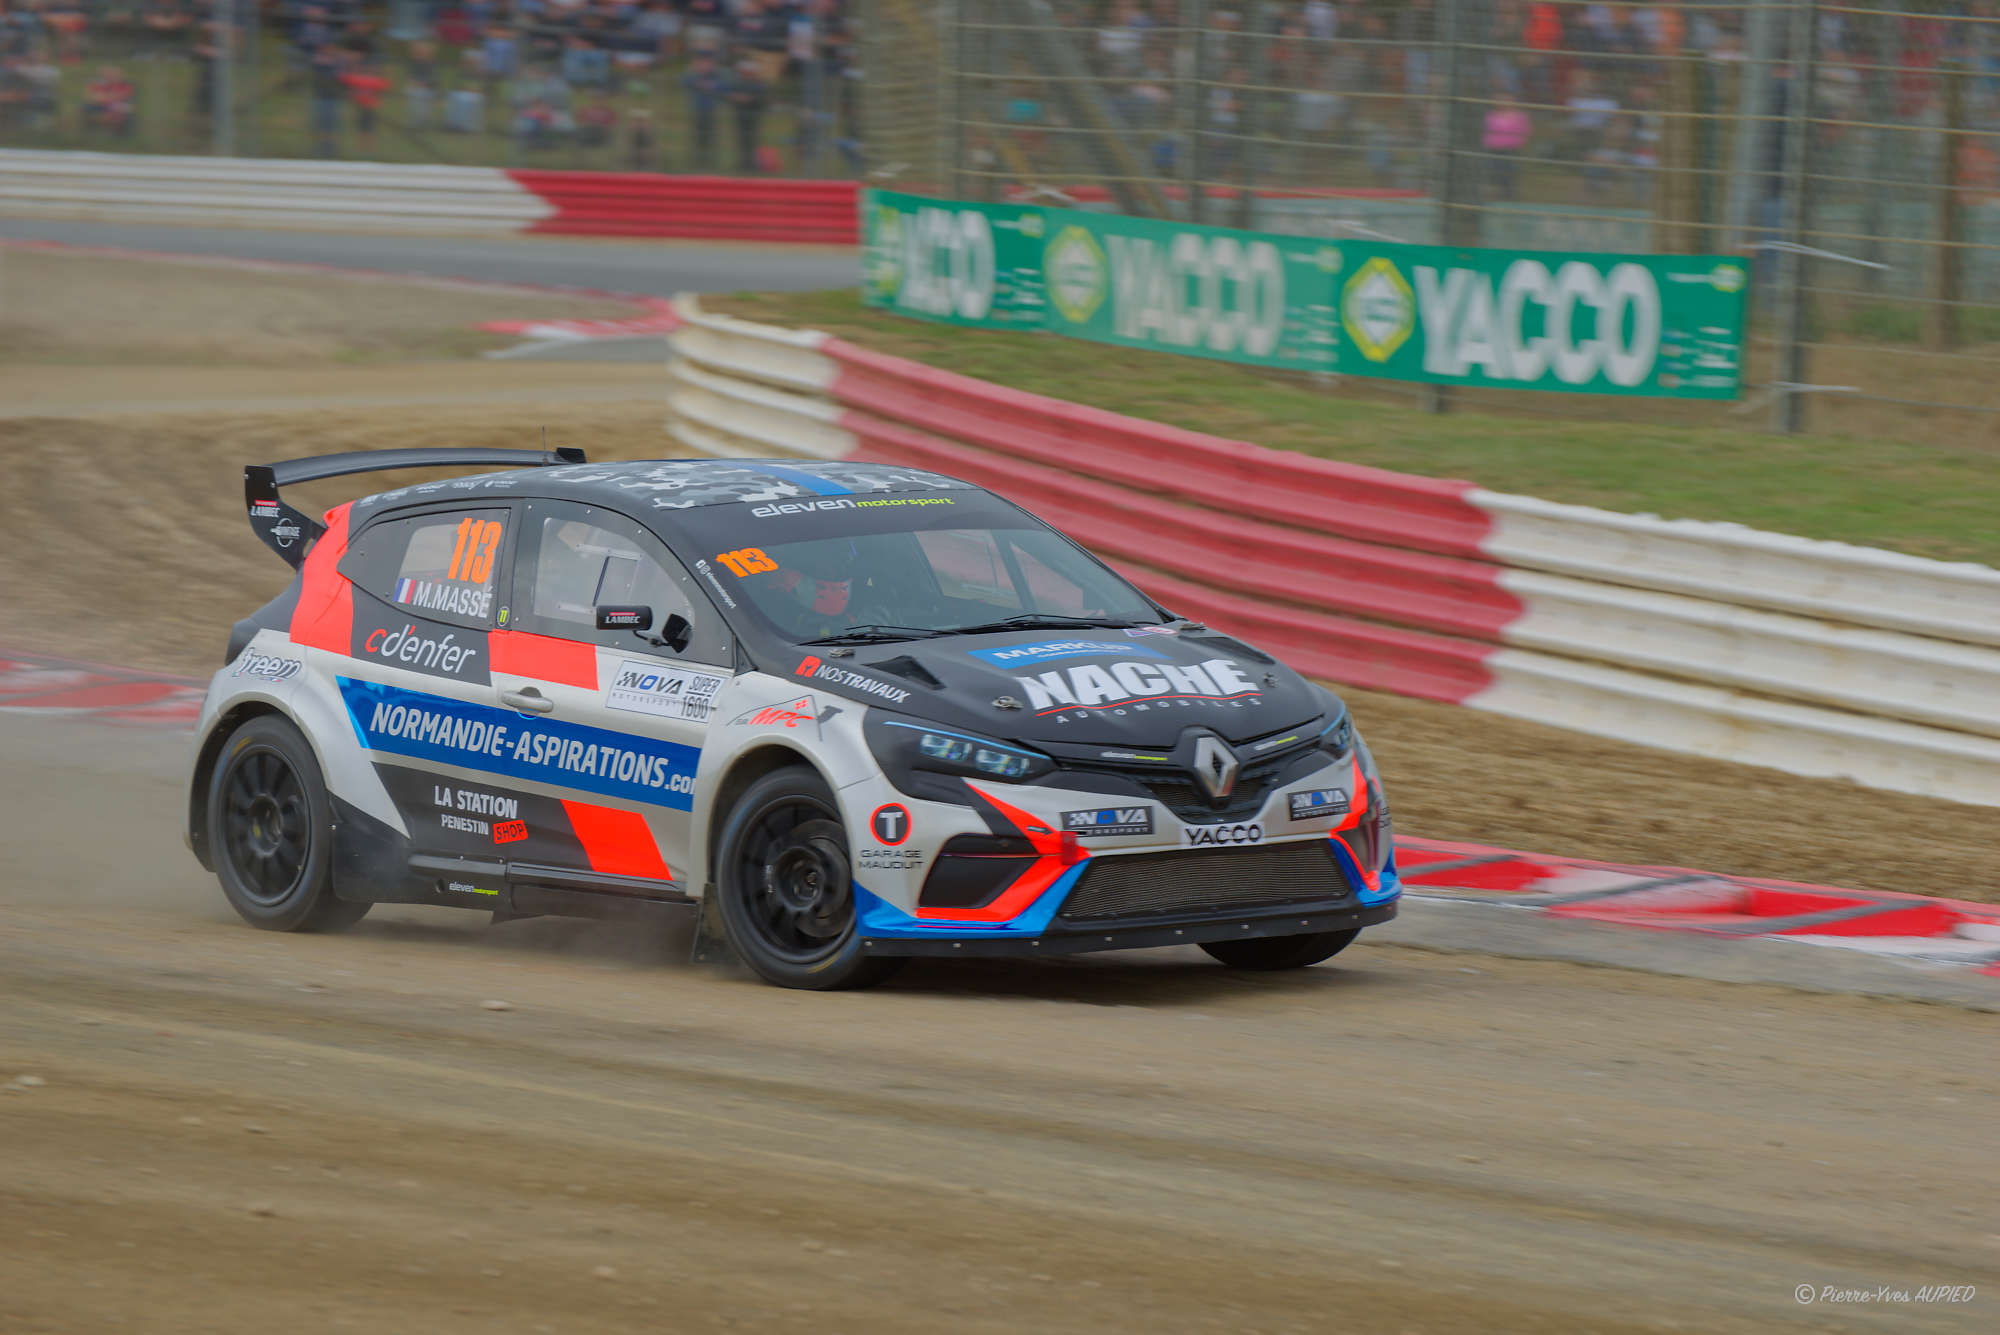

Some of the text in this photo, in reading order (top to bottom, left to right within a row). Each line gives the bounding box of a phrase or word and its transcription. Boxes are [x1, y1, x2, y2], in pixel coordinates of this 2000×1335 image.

[1105, 231, 1285, 357] YACCO
[1413, 259, 1660, 386] YACCO
[751, 496, 955, 518] eleven motorsport
[448, 517, 503, 584] 113
[715, 547, 779, 578] 113
[413, 579, 493, 619] M.MASSÉ
[1013, 659, 1259, 711] NACHE
[680, 695, 710, 720] 1600
[748, 707, 816, 728] MPC
[434, 785, 518, 819] LA STATION
[440, 814, 524, 841] PENESTIN SHOP
[879, 811, 904, 839] T
[1184, 824, 1262, 846] YACCO
[860, 849, 922, 858] GARAGE
